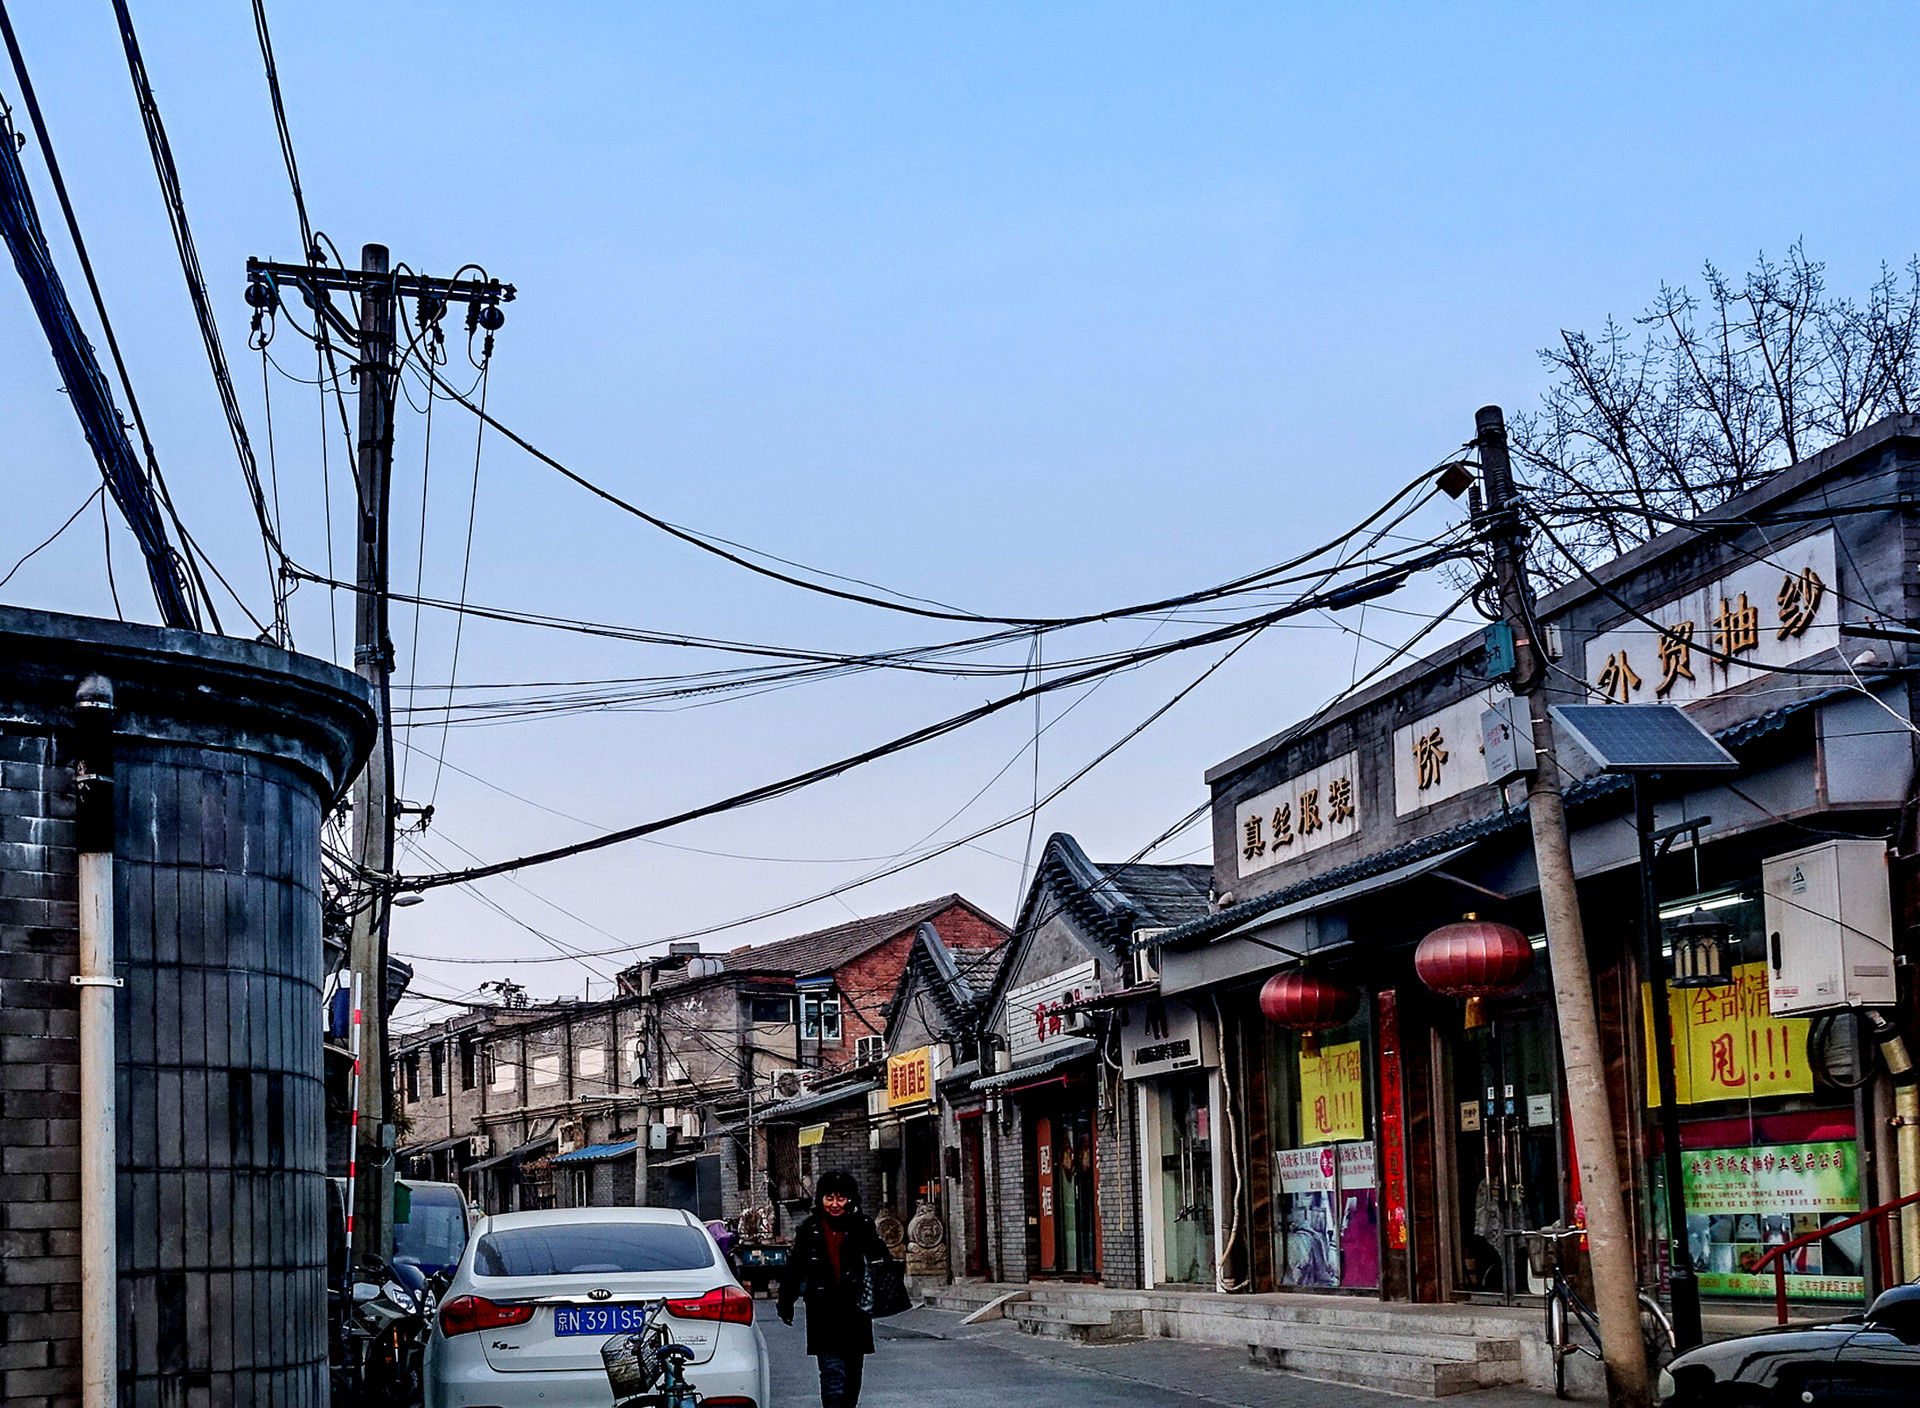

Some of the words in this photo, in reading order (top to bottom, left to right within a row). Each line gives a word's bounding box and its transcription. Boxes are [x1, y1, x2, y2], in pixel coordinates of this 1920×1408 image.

[1597, 566, 1825, 704] 外贸抽纱
[1242, 776, 1355, 860] 真丝服装
